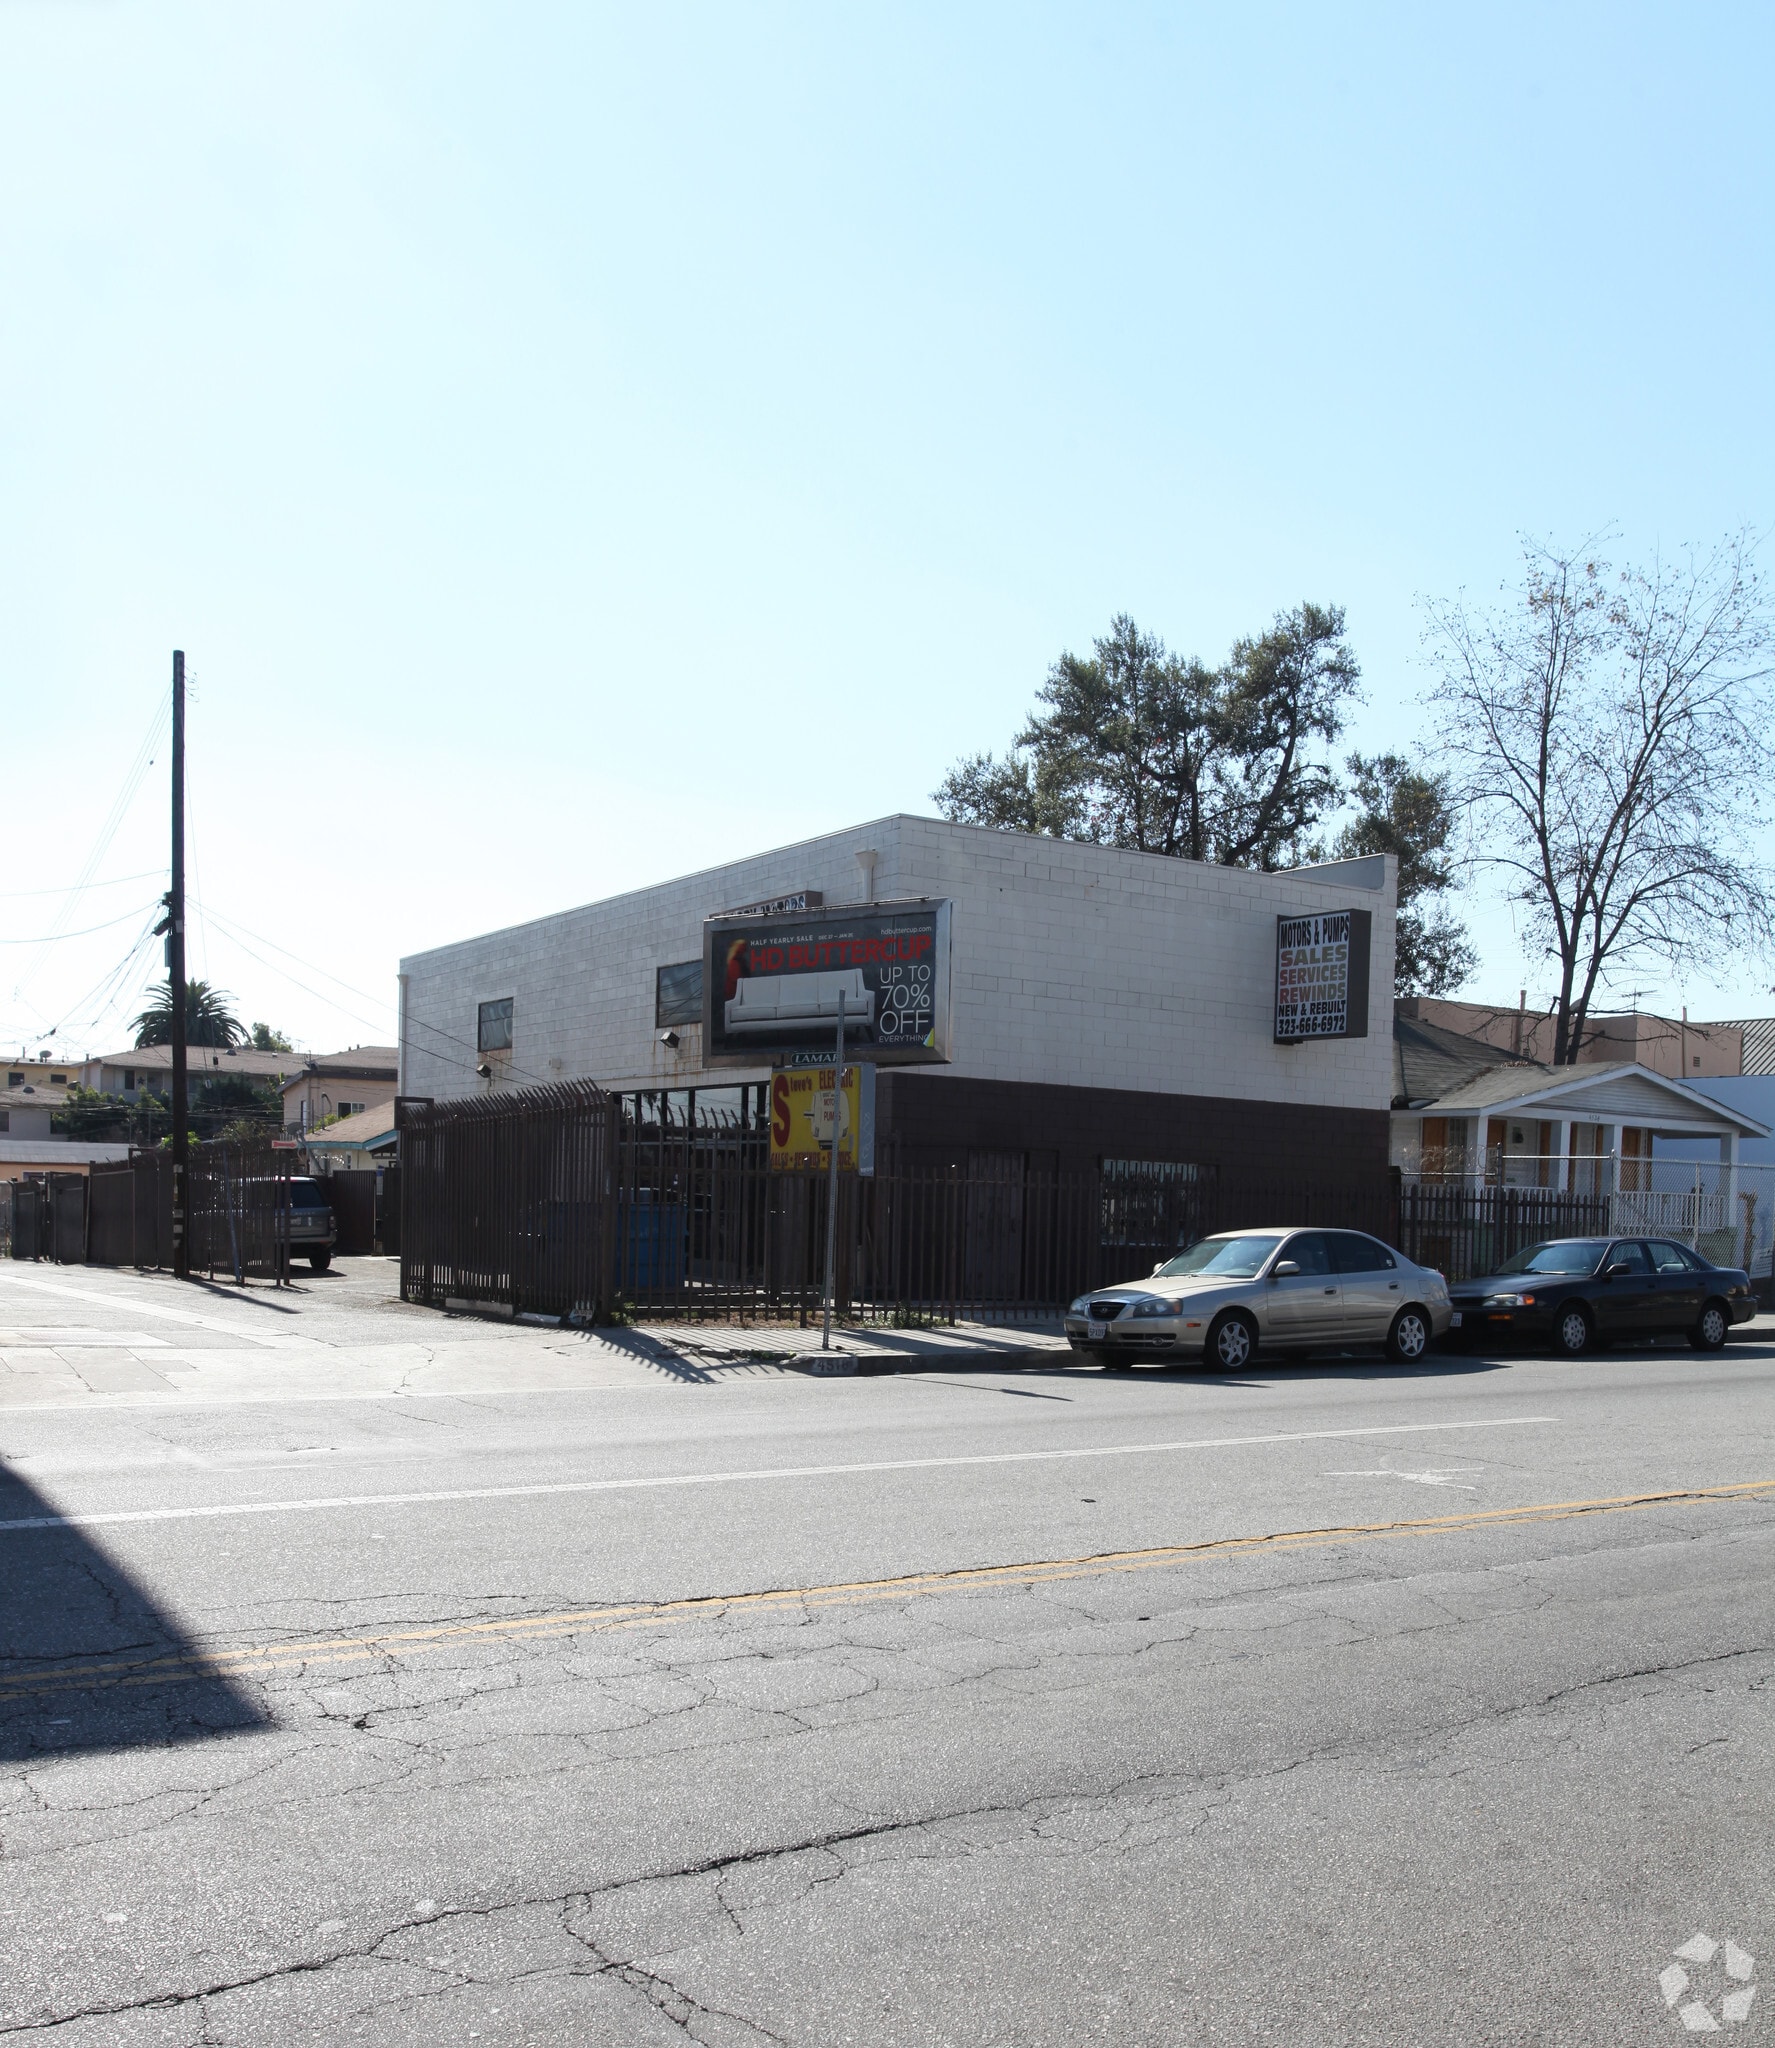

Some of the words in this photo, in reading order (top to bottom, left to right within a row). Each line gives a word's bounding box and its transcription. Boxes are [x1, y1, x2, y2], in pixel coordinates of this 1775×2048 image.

[770, 937, 794, 945] YEARLY
[881, 926, 932, 935] hdbuttercup.com
[1280, 920, 1311, 949] MOTORS
[1314, 918, 1320, 946] &
[1323, 915, 1350, 944] PUMPS
[750, 946, 784, 972] HD
[789, 935, 931, 968] BUTTERCUP
[1281, 944, 1347, 967] SALES
[880, 966, 903, 984] UP
[908, 965, 931, 982] TO
[1280, 963, 1346, 986] SERVICES
[880, 983, 930, 1009] 70%
[1280, 982, 1345, 1004] REWINDS
[1279, 1003, 1298, 1017] NEW
[1301, 1002, 1307, 1016] &
[1310, 1000, 1346, 1015] REBUILT
[880, 1009, 930, 1035] OFF
[1278, 1014, 1345, 1035] 323-666-6972
[773, 1074, 813, 1148] Steve's
[819, 1067, 854, 1091] ELECRIC
[824, 1110, 841, 1121] PUMS
